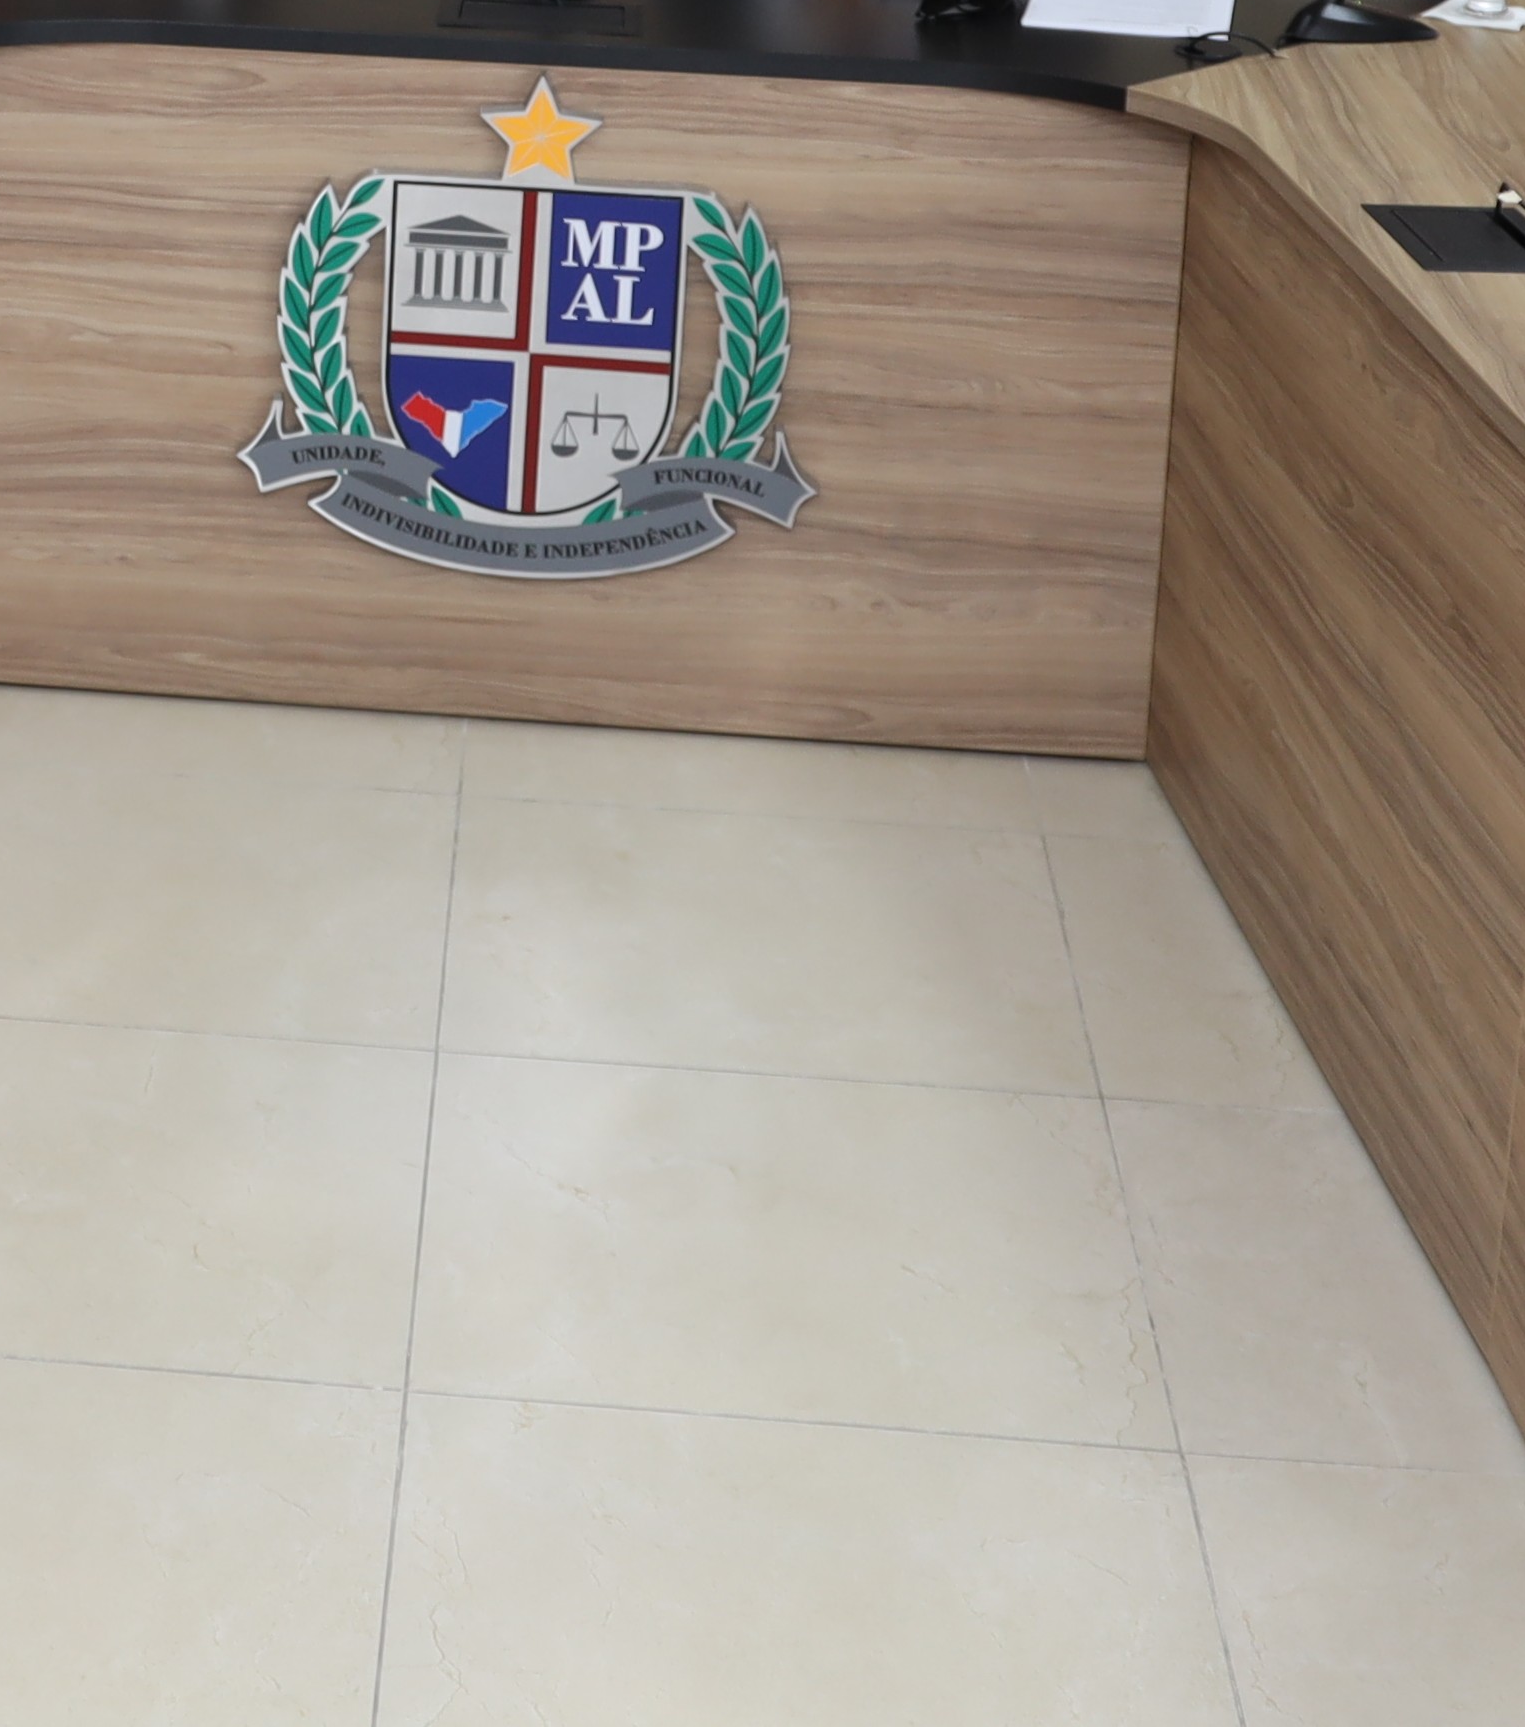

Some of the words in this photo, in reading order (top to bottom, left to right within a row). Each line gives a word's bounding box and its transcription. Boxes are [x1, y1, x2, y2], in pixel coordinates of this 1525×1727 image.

[561, 217, 664, 272] MP
[560, 272, 654, 326] AL
[291, 445, 387, 467] UNIDADE,
[653, 467, 766, 498] FUNCIONAL
[340, 492, 519, 559] INDIVISIBILIDADE
[524, 543, 539, 559] E
[543, 519, 709, 560] INDEPENDÊNCIA
